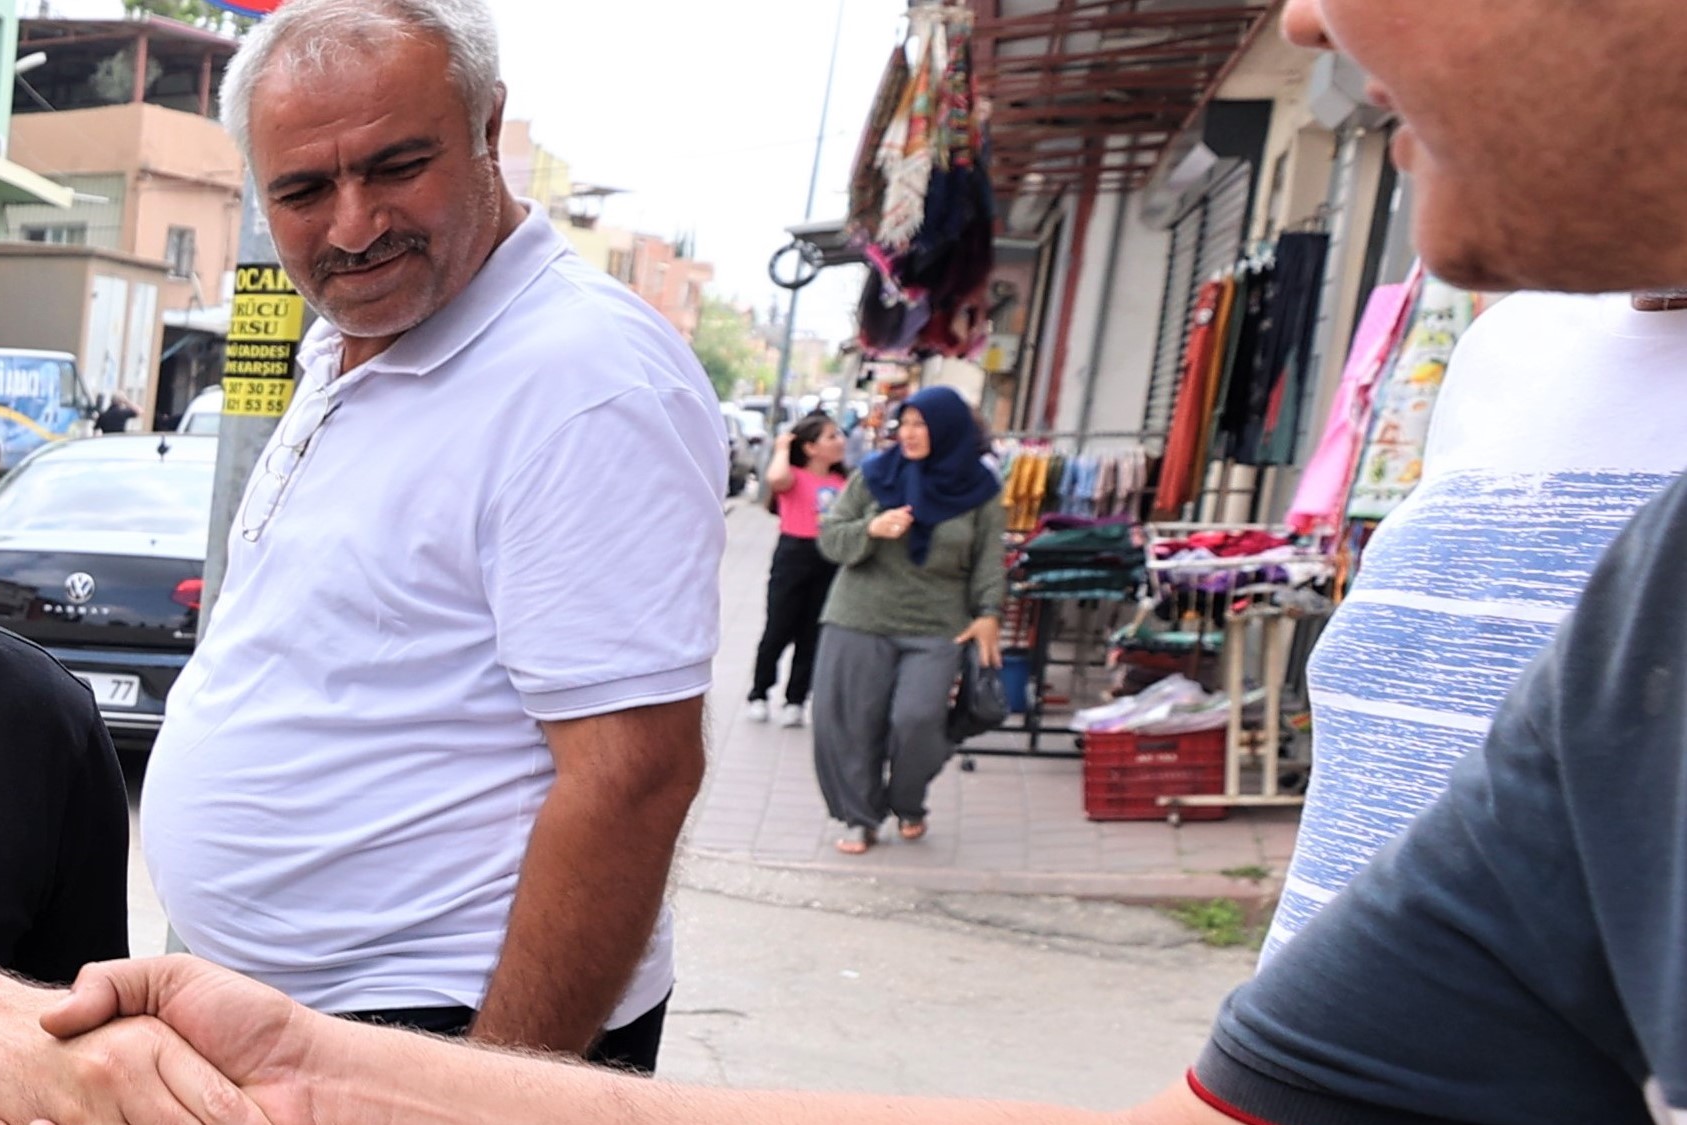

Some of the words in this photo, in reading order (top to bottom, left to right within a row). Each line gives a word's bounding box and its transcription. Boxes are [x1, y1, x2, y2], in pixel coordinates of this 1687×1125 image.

[232, 299, 289, 317] RÜCÜ
[247, 381, 263, 395] 30
[269, 383, 286, 396] 27
